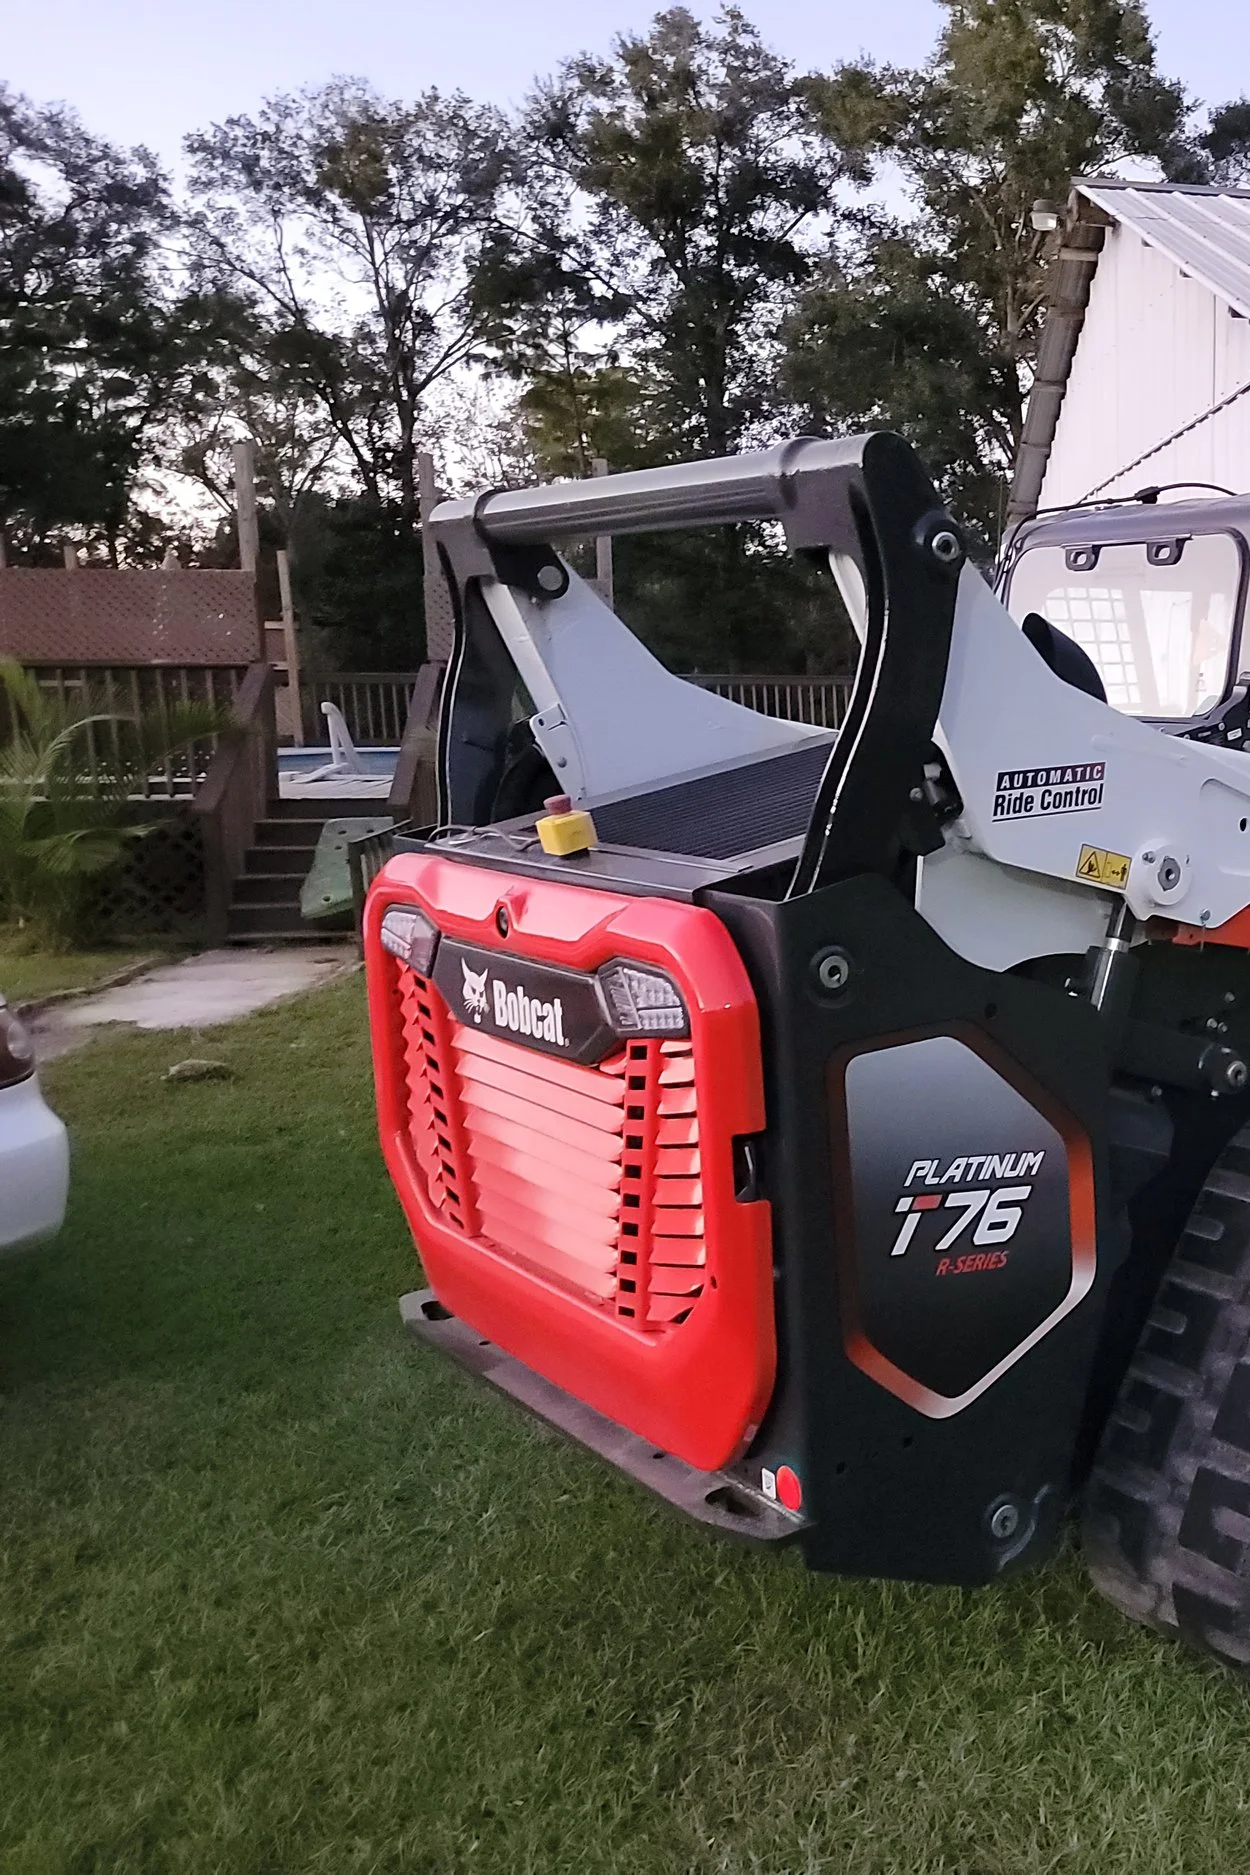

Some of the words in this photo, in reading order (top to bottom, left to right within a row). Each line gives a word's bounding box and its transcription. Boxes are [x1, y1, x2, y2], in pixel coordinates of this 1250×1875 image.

[999, 765, 1103, 790] AUTOMATIC
[993, 792, 1035, 817] Ride
[1040, 783, 1104, 811] Control
[492, 979, 566, 1047] Bobcat
[903, 1151, 1045, 1187] PLATINUM
[891, 1185, 1032, 1257] T76
[936, 1251, 1009, 1276] R-SERIES
